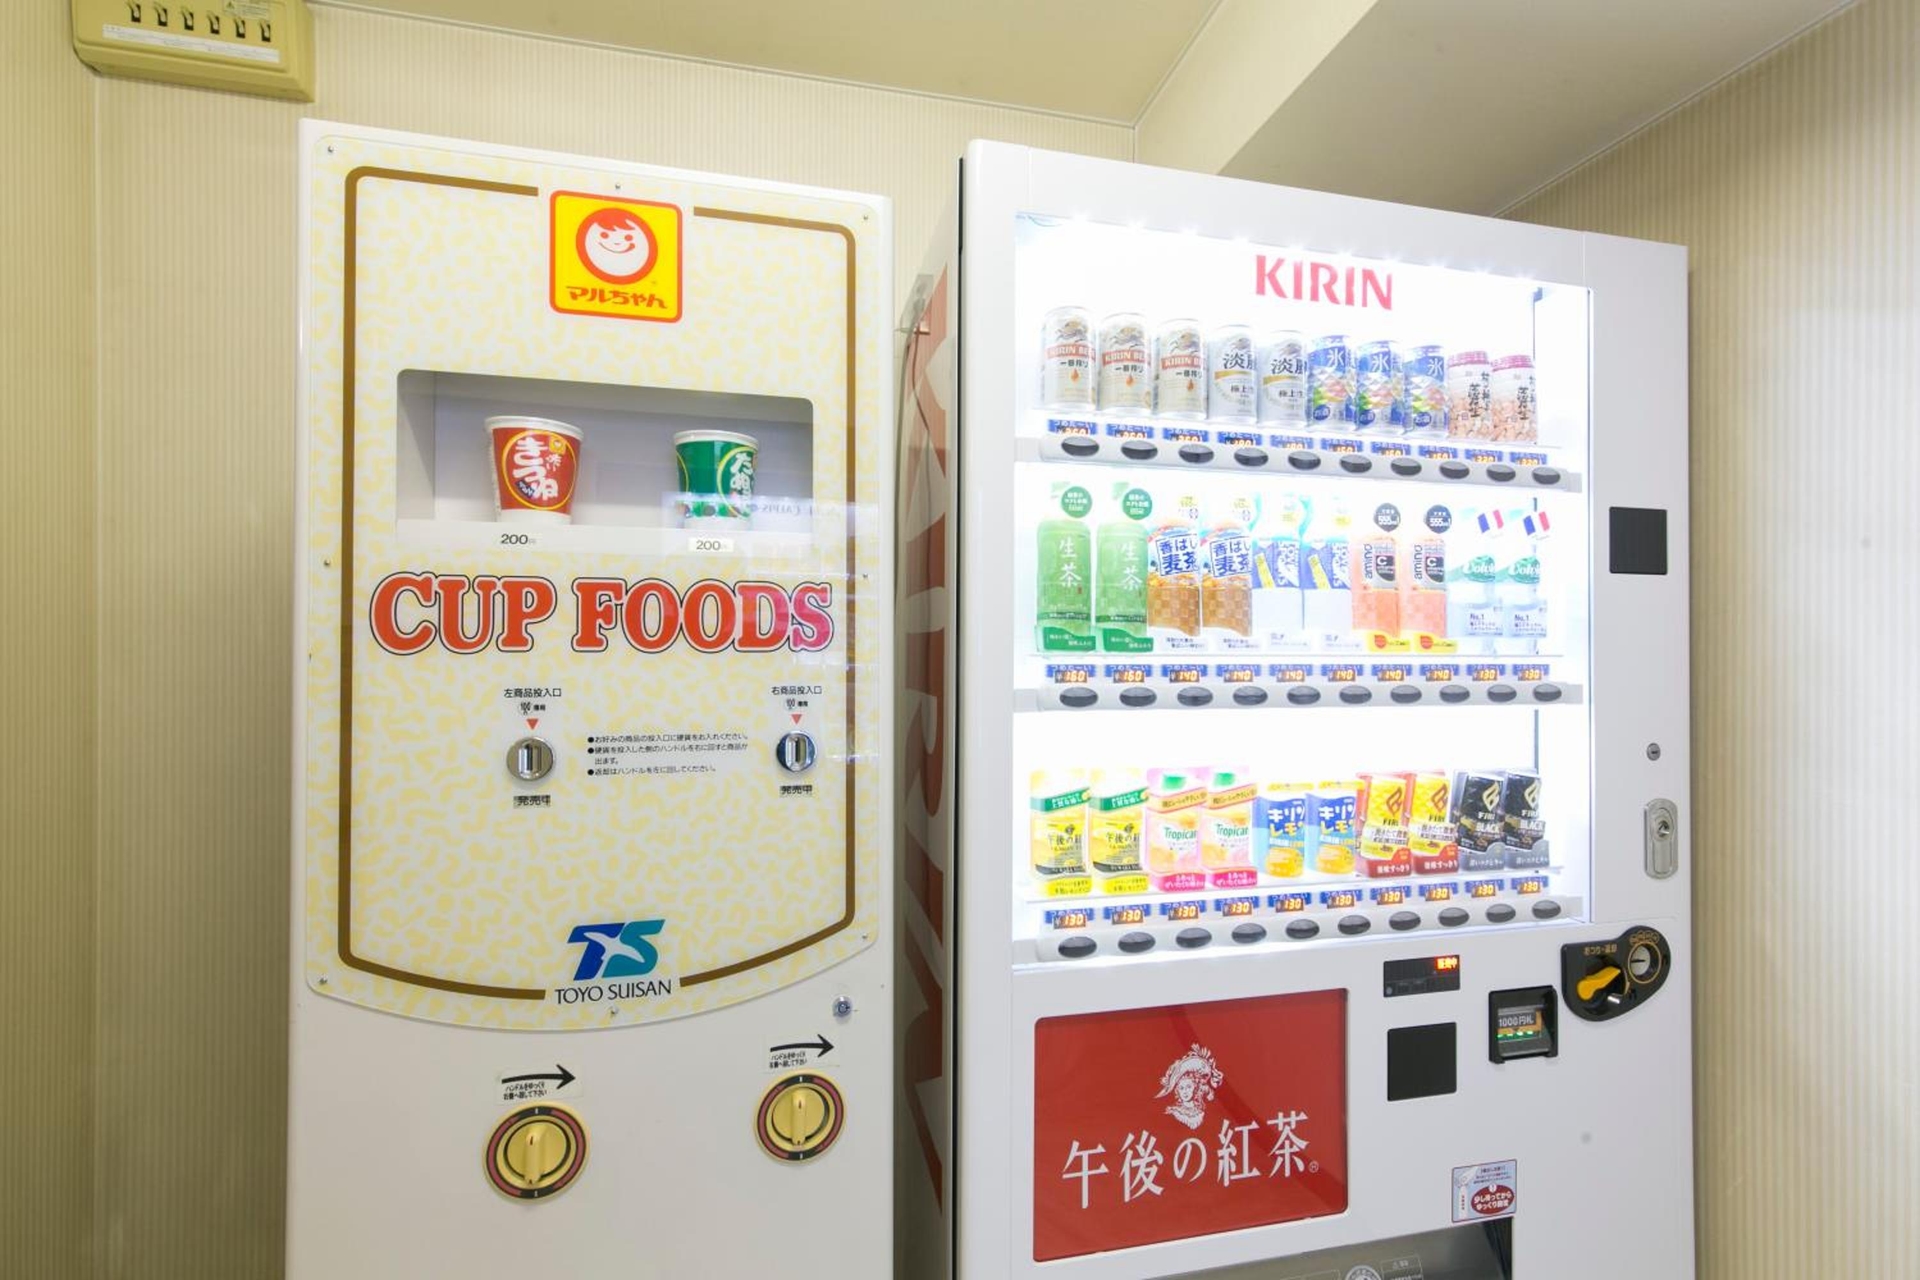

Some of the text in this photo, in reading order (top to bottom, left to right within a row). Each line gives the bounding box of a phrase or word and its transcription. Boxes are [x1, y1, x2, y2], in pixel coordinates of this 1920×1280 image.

[566, 286, 667, 309] マルちゃん
[1256, 254, 1392, 311] KIRIN
[1364, 543, 1373, 580] amino
[1413, 544, 1423, 580] amino
[370, 572, 834, 655] CUP FOODS
[504, 687, 562, 699] 左商品投入口
[771, 686, 823, 695] 右商品投入口
[555, 979, 672, 1005] TOYO SUISAN
[1062, 1110, 1310, 1210] 午後の紅茶
